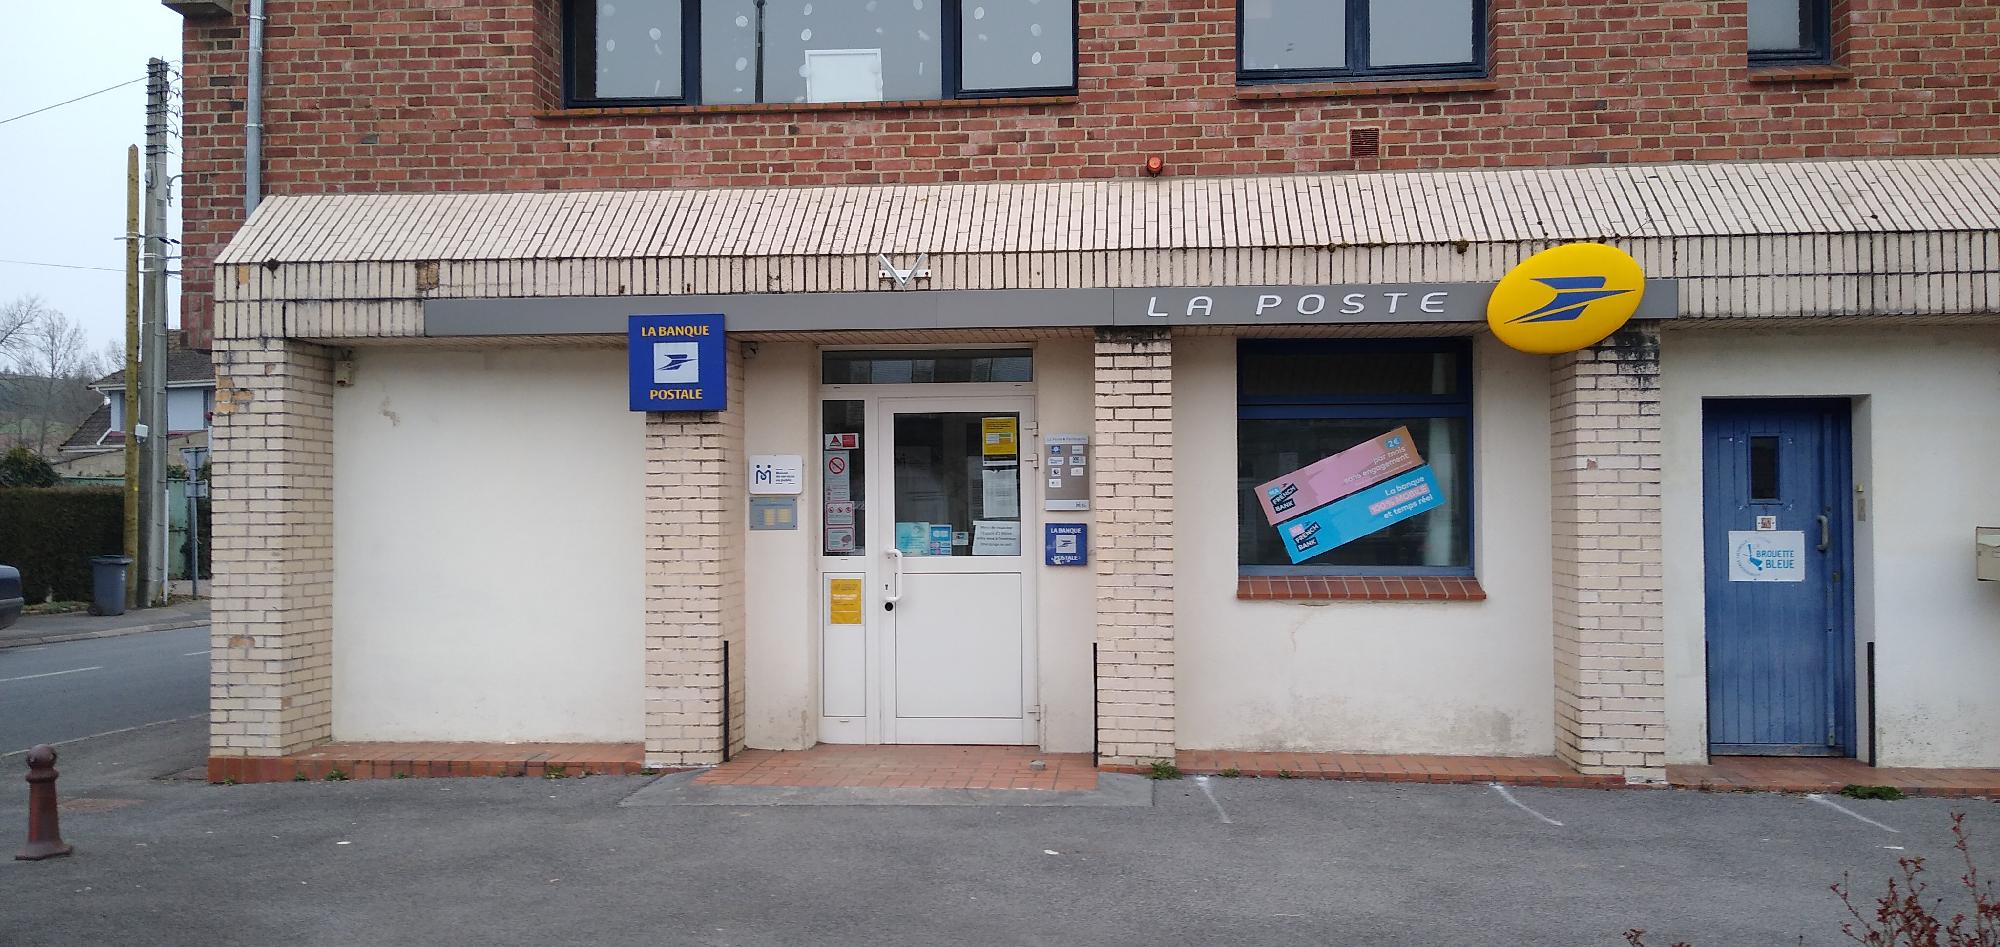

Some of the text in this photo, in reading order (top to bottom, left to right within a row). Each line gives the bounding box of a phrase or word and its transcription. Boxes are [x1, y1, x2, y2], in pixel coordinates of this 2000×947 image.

[1147, 292, 1448, 317] LA POSTE
[641, 325, 710, 338] LA BANQUE
[649, 389, 703, 400] POSTALE
[1388, 438, 1400, 447] 2€
[1373, 446, 1406, 464] par mois
[1344, 453, 1410, 484] sans engagement
[1396, 476, 1425, 491] banque
[1272, 486, 1297, 504] FRENCH
[1275, 501, 1294, 512] BANK
[1384, 494, 1433, 519] et temps réel
[1295, 524, 1319, 543] FRENCH
[1298, 539, 1316, 550] BANK
[1766, 560, 1794, 568] BLEUE
